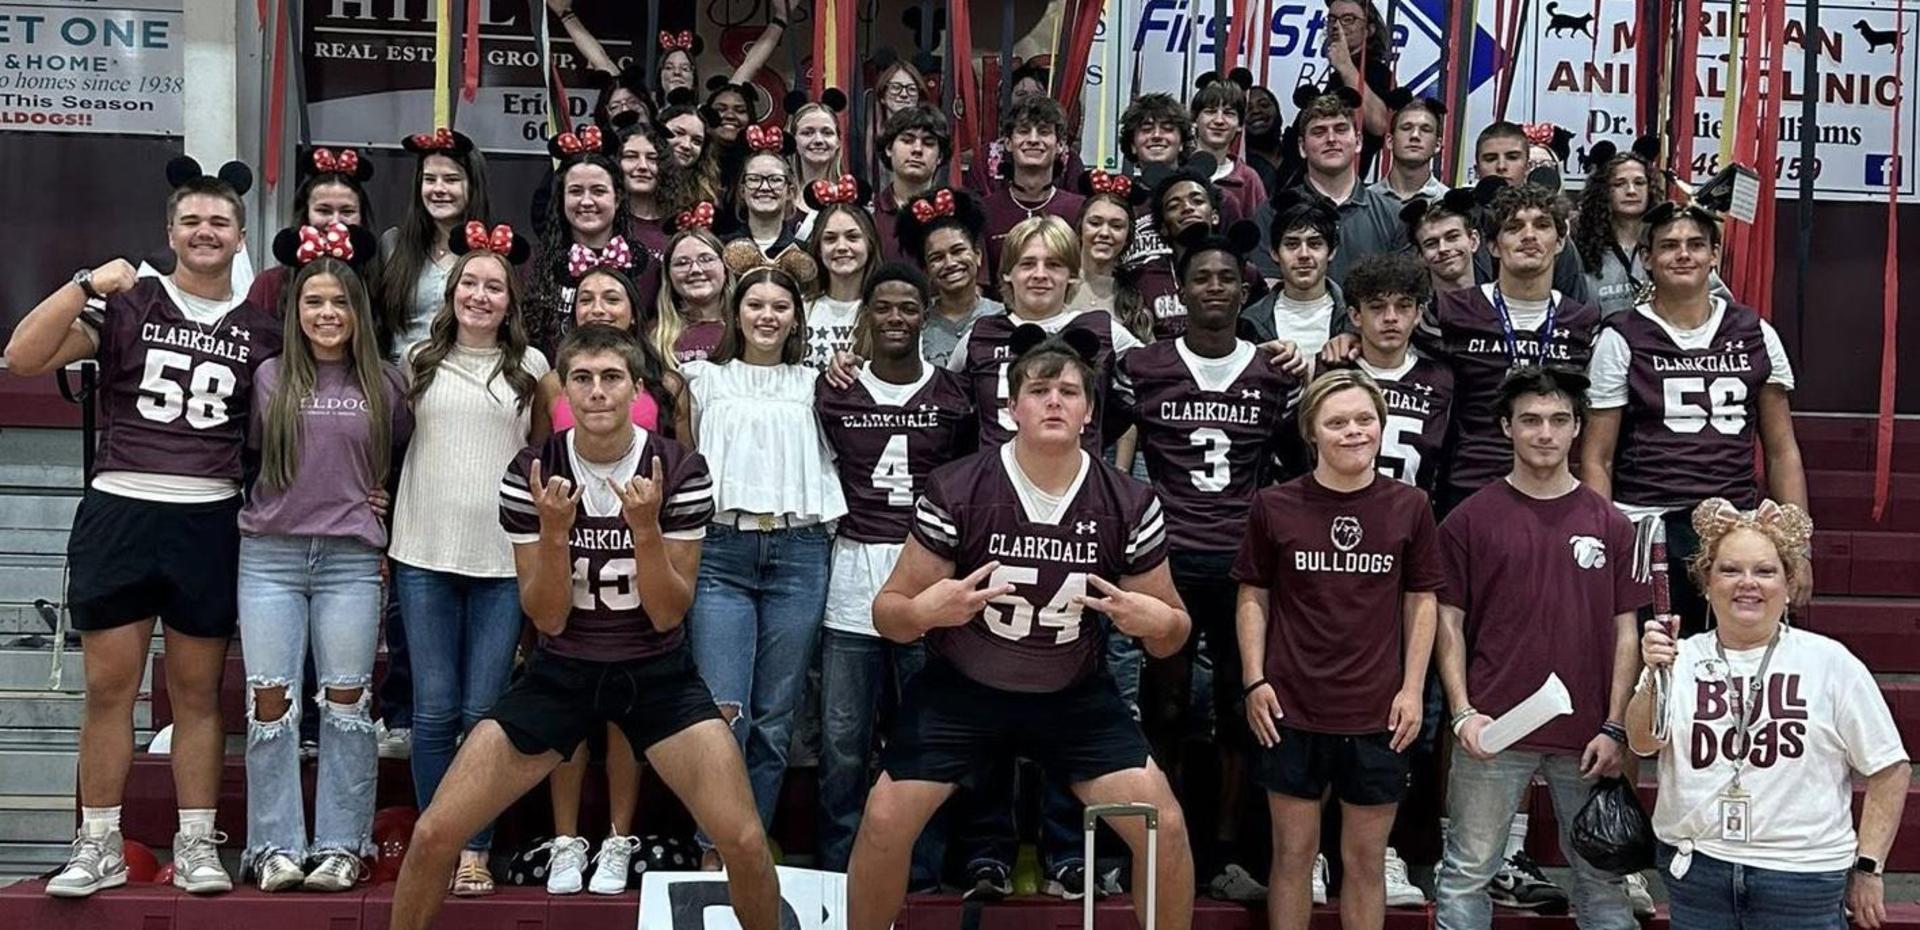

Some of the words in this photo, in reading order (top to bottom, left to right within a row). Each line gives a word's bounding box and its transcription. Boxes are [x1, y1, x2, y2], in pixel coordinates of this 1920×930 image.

[60, 17, 169, 49] ONE
[1133, 0, 1245, 54] Firs
[1269, 5, 1409, 62] Ste
[5, 54, 20, 69] &
[27, 54, 108, 72] HOME
[314, 42, 378, 60] REAL
[14, 72, 76, 90] homes
[82, 75, 131, 92] since
[139, 76, 184, 94] 1938
[1296, 63, 1337, 94] BA
[1547, 61, 1726, 100] ANIL
[1, 94, 53, 108] This
[62, 96, 153, 111] Season
[1590, 110, 1634, 135] Dr.
[141, 323, 250, 363] CLARKDALE
[1652, 353, 1752, 372] CLARKDALE
[136, 349, 237, 429] 58
[841, 412, 939, 429] CLARKDALE
[1161, 401, 1261, 424] CLARKDALE
[1663, 377, 1748, 434] 56
[870, 433, 914, 506] 4
[1189, 427, 1233, 492] 3
[988, 533, 1098, 564] CLARKDALE
[1294, 550, 1395, 574] BULLDOGS
[984, 564, 1088, 645] 54
[1693, 672, 1809, 727] BULL
